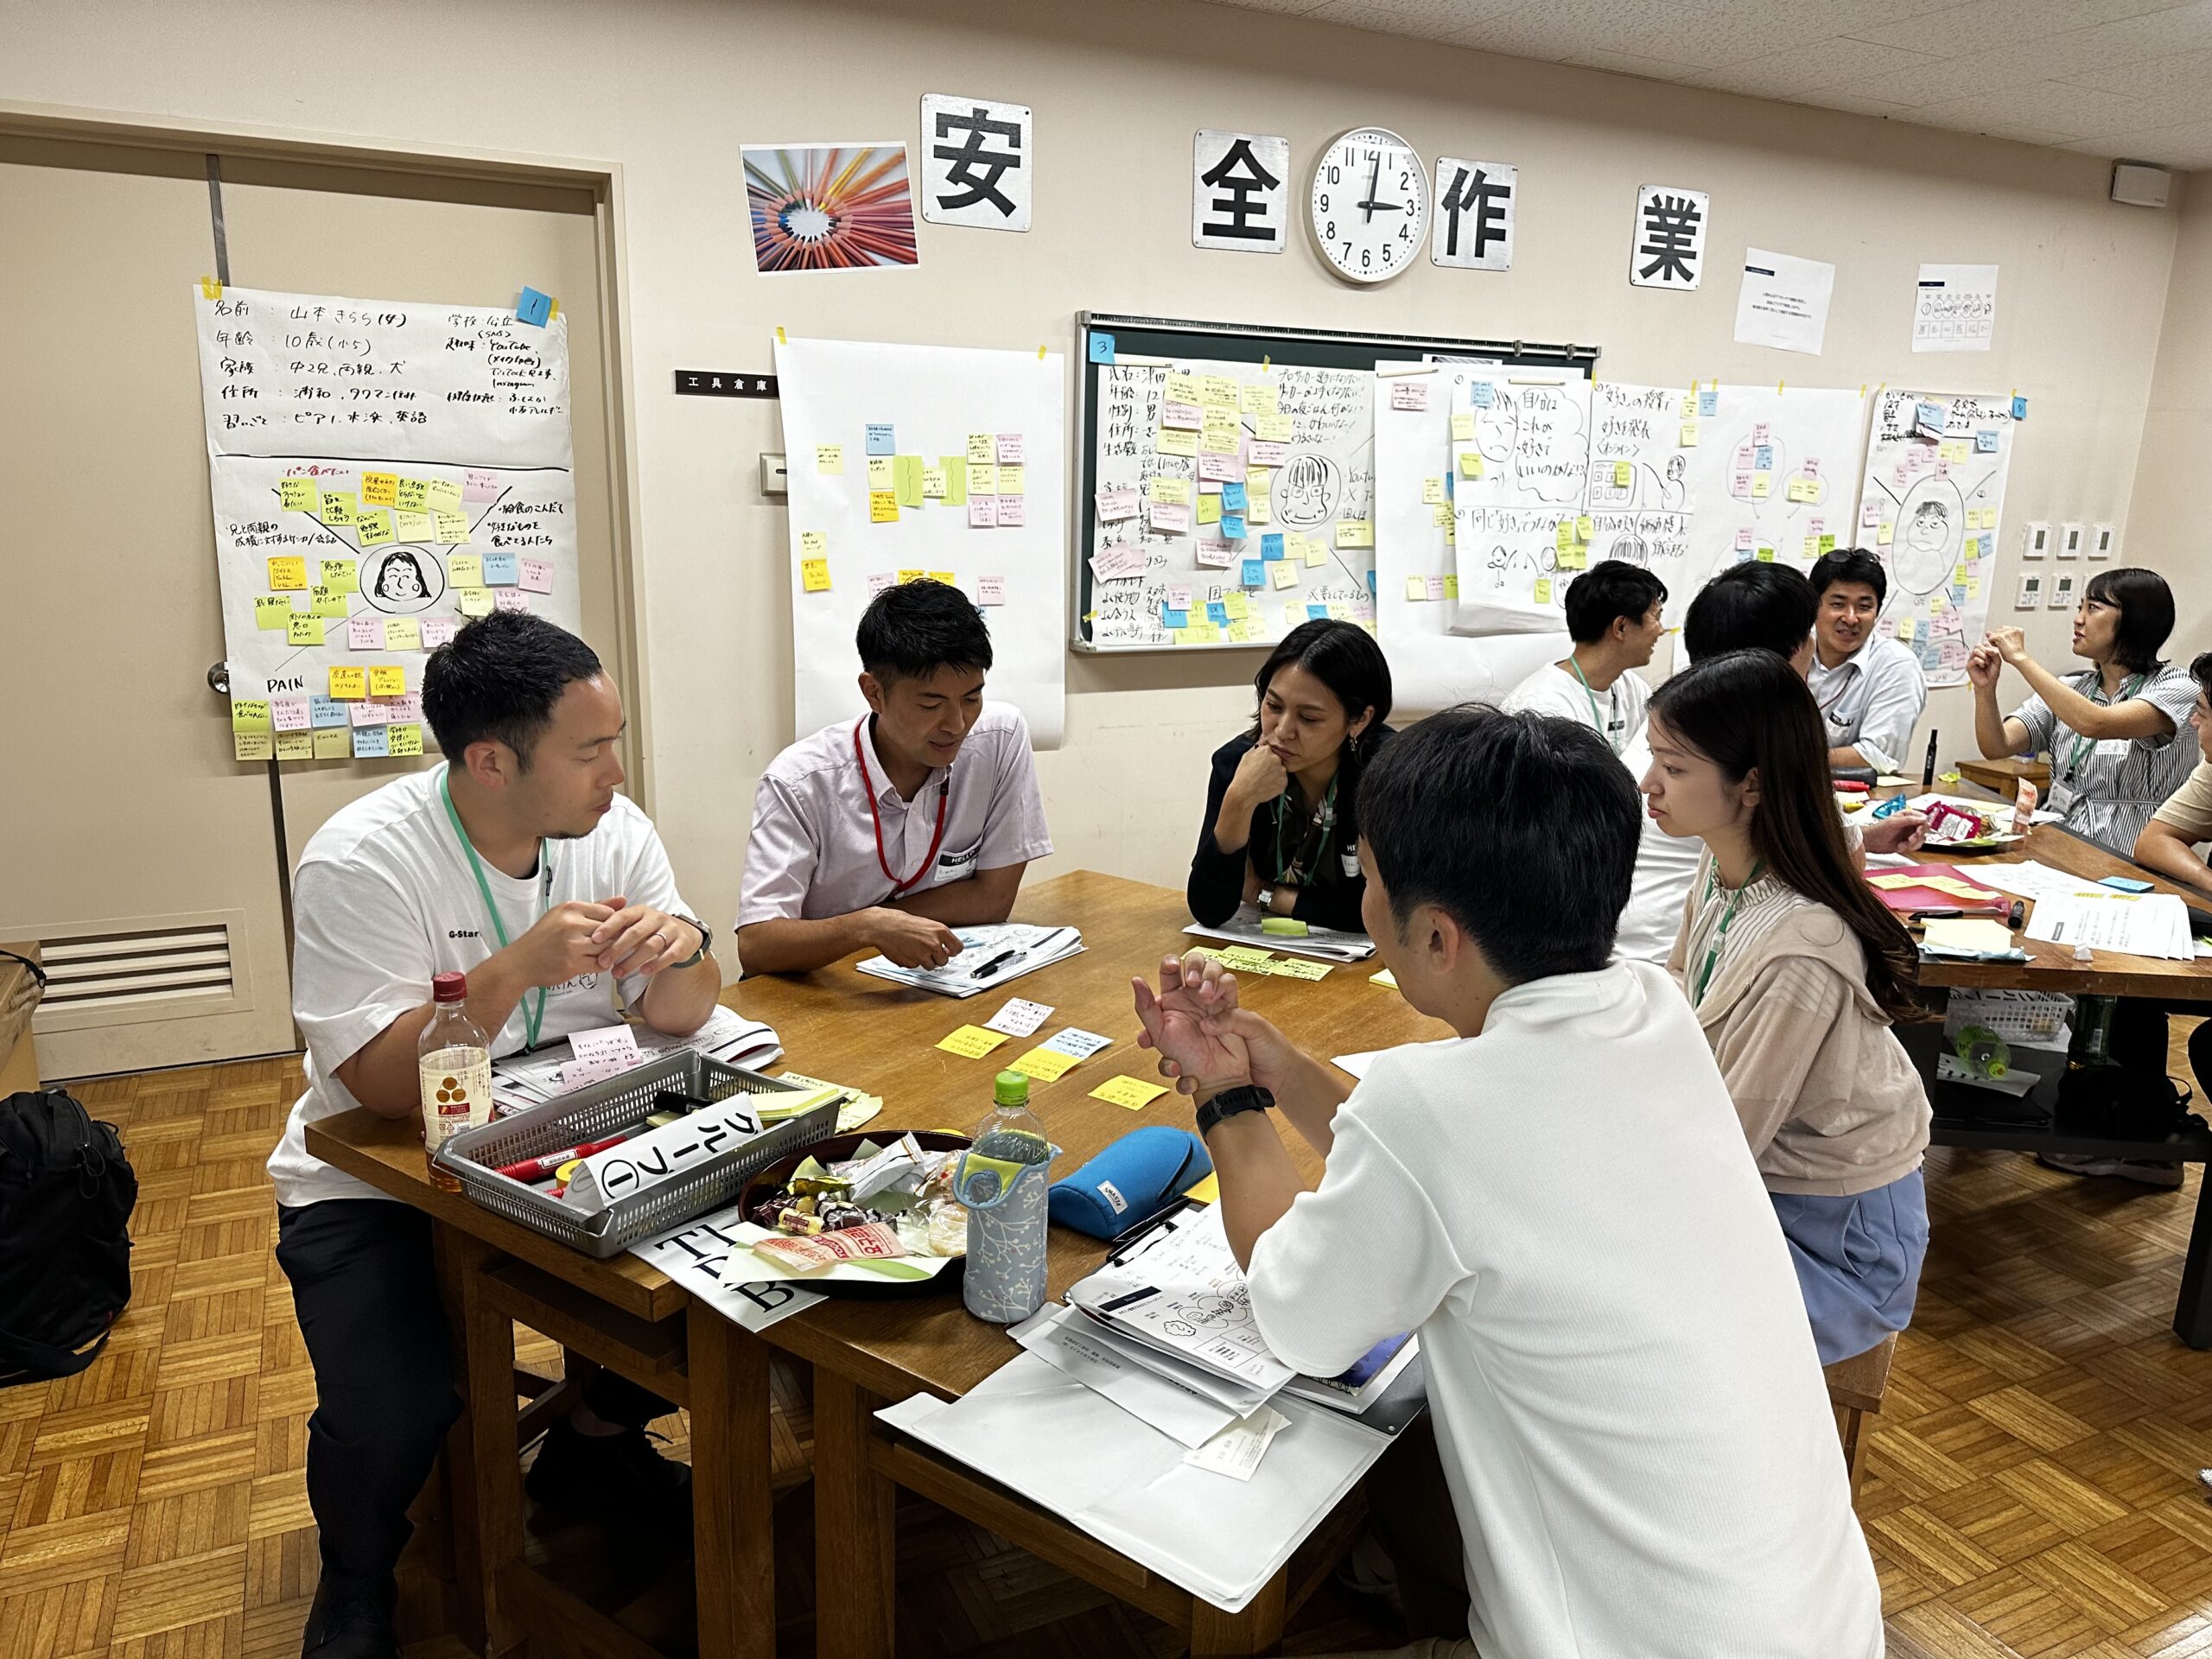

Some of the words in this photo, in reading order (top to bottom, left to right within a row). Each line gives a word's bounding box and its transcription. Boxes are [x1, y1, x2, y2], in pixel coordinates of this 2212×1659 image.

[1344, 147, 1355, 167] 11
[1327, 165, 1340, 185] 10
[1400, 172, 1409, 191] 2
[1320, 194, 1329, 213] 9
[1406, 199, 1415, 217] 3
[1325, 221, 1336, 240] 8
[1398, 224, 1409, 241] 4
[1343, 242, 1352, 261] 7
[1362, 249, 1370, 267] 6
[1382, 244, 1392, 262] 5
[1099, 341, 1108, 353] 3
[689, 377, 767, 391] 工具倉庫
[266, 675, 304, 693] PAIN
